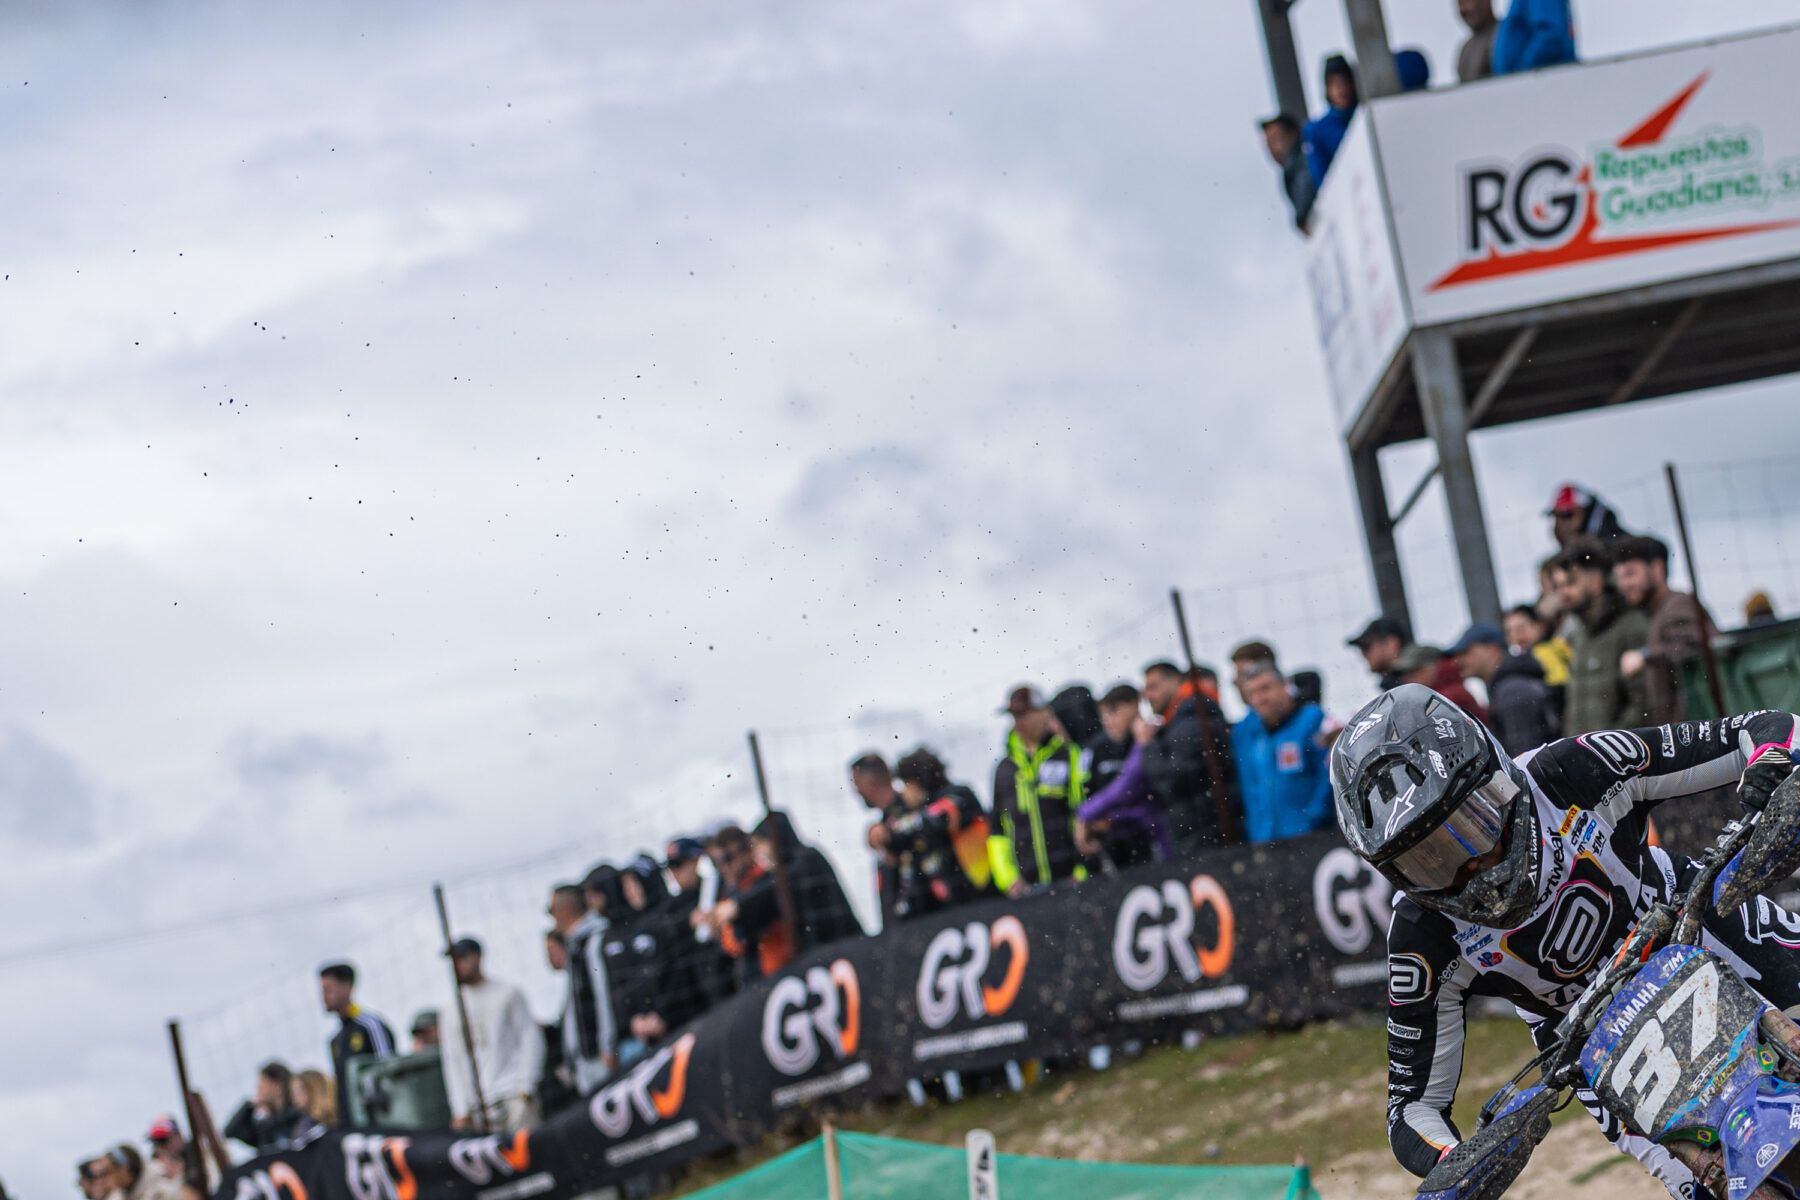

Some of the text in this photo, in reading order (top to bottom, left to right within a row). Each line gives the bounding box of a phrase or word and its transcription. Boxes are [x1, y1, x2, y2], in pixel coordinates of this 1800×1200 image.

[1597, 136, 1751, 186] Repuestos
[1468, 156, 1580, 251] RG
[1601, 781, 1625, 807] aero
[1609, 981, 1661, 1038] YAMAHA
[1611, 961, 1720, 1136] 37
